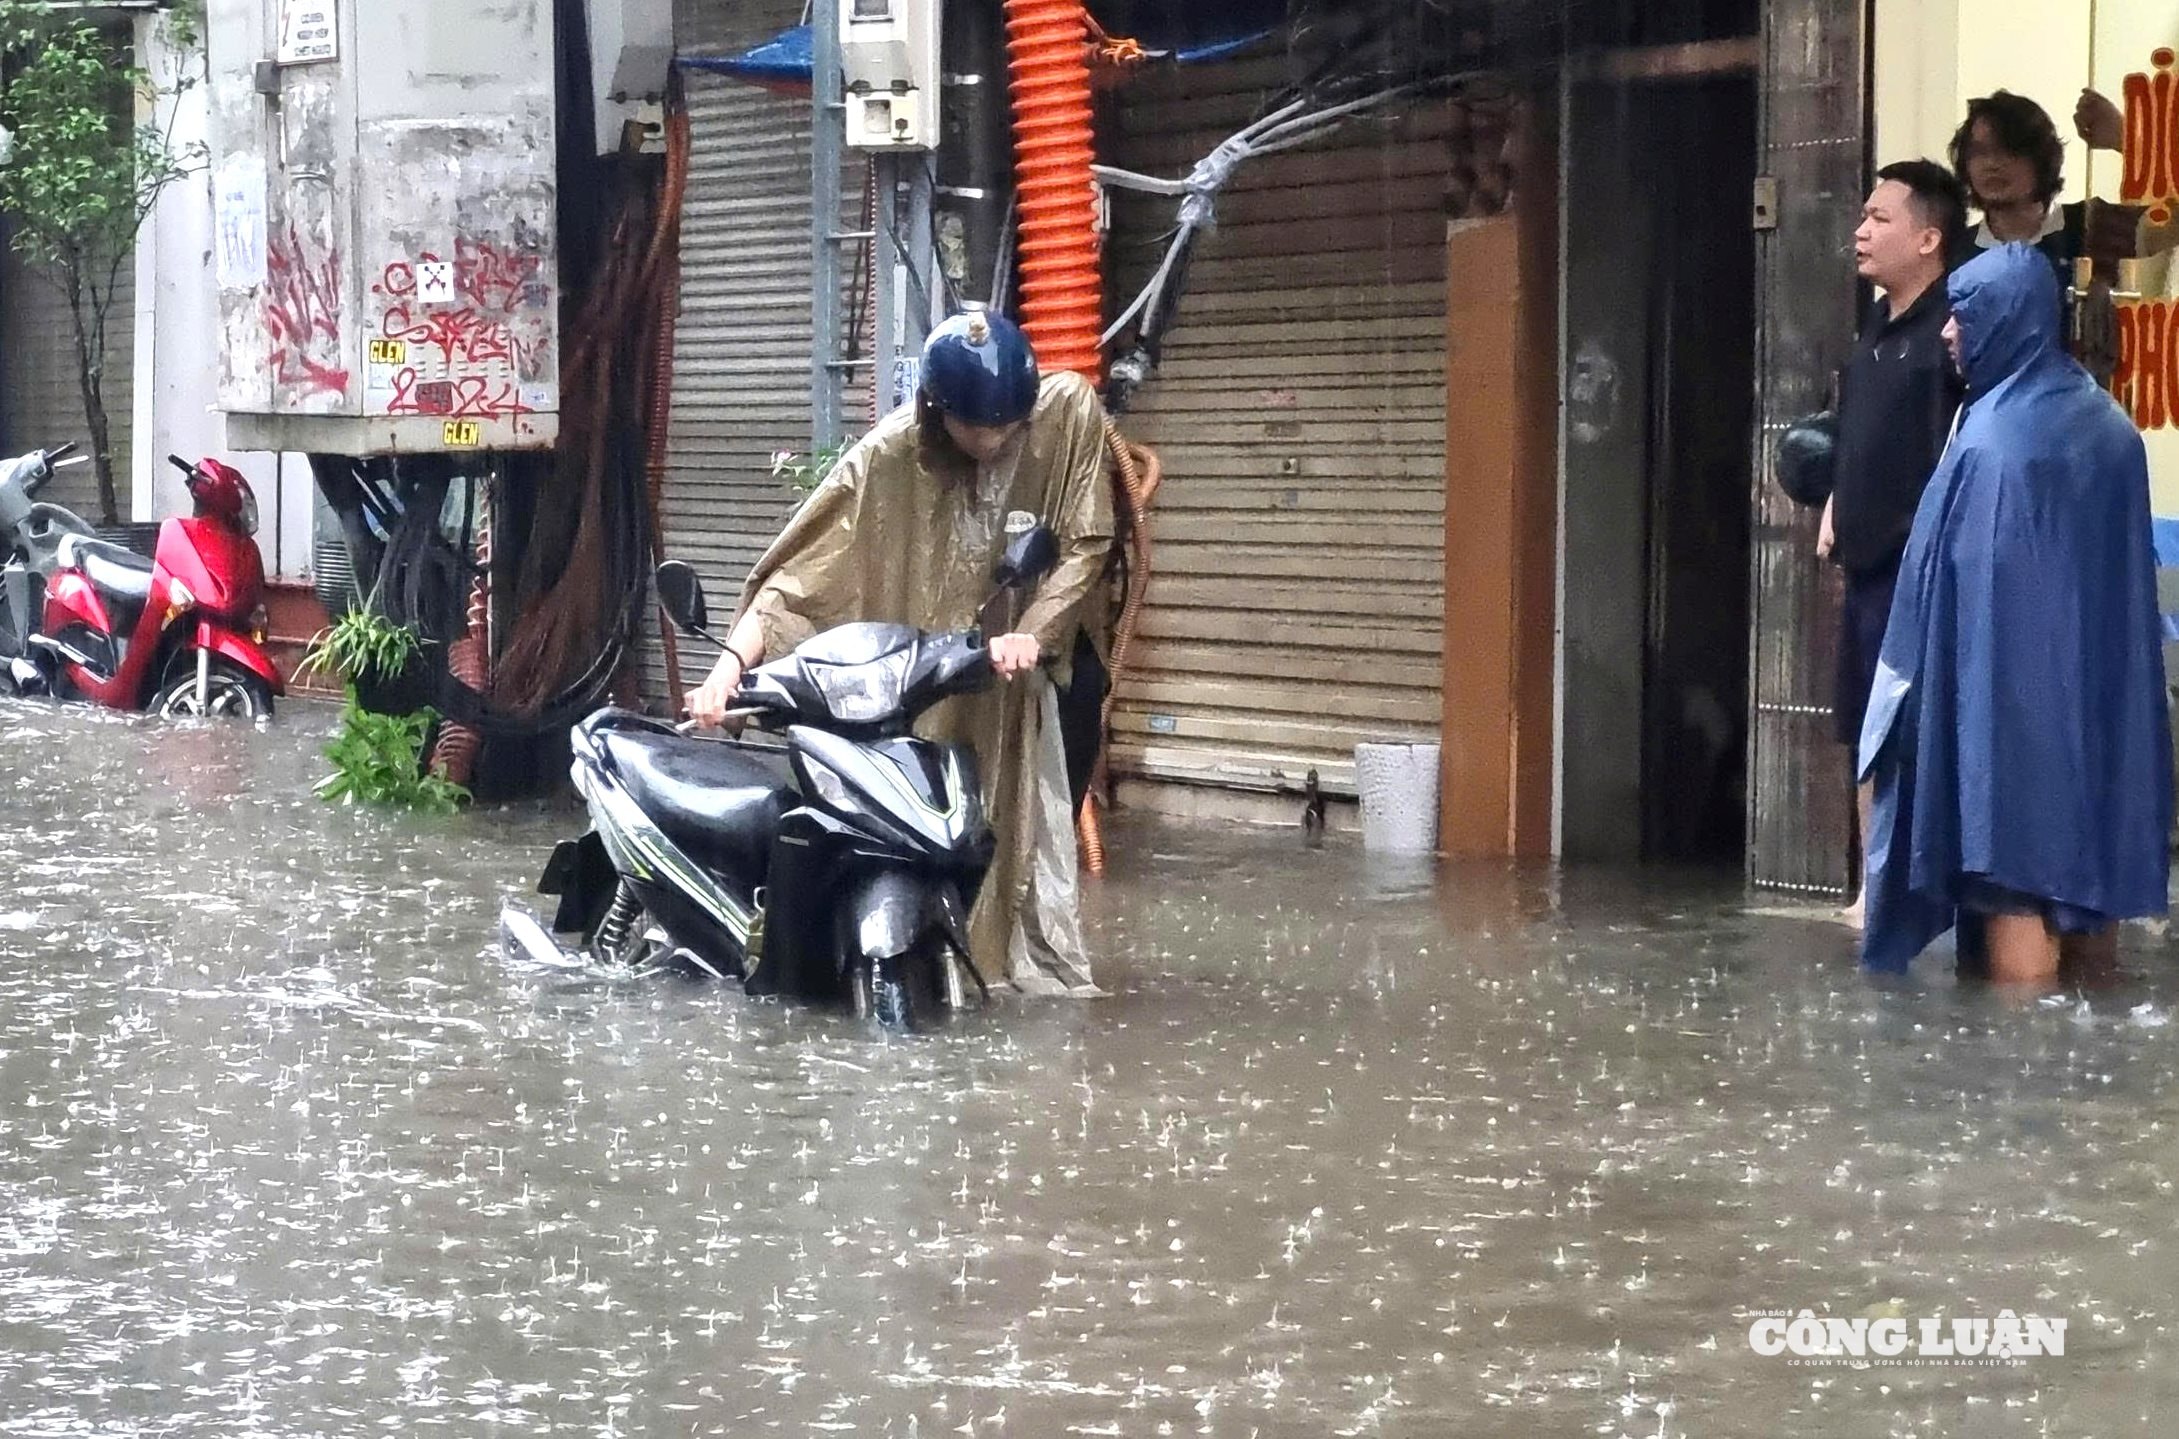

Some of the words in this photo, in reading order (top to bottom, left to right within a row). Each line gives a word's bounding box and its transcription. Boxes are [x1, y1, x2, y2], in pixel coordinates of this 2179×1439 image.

[2121, 47, 2179, 225] DỊ
[370, 341, 405, 364] GLEN
[444, 421, 479, 445] GLEN
